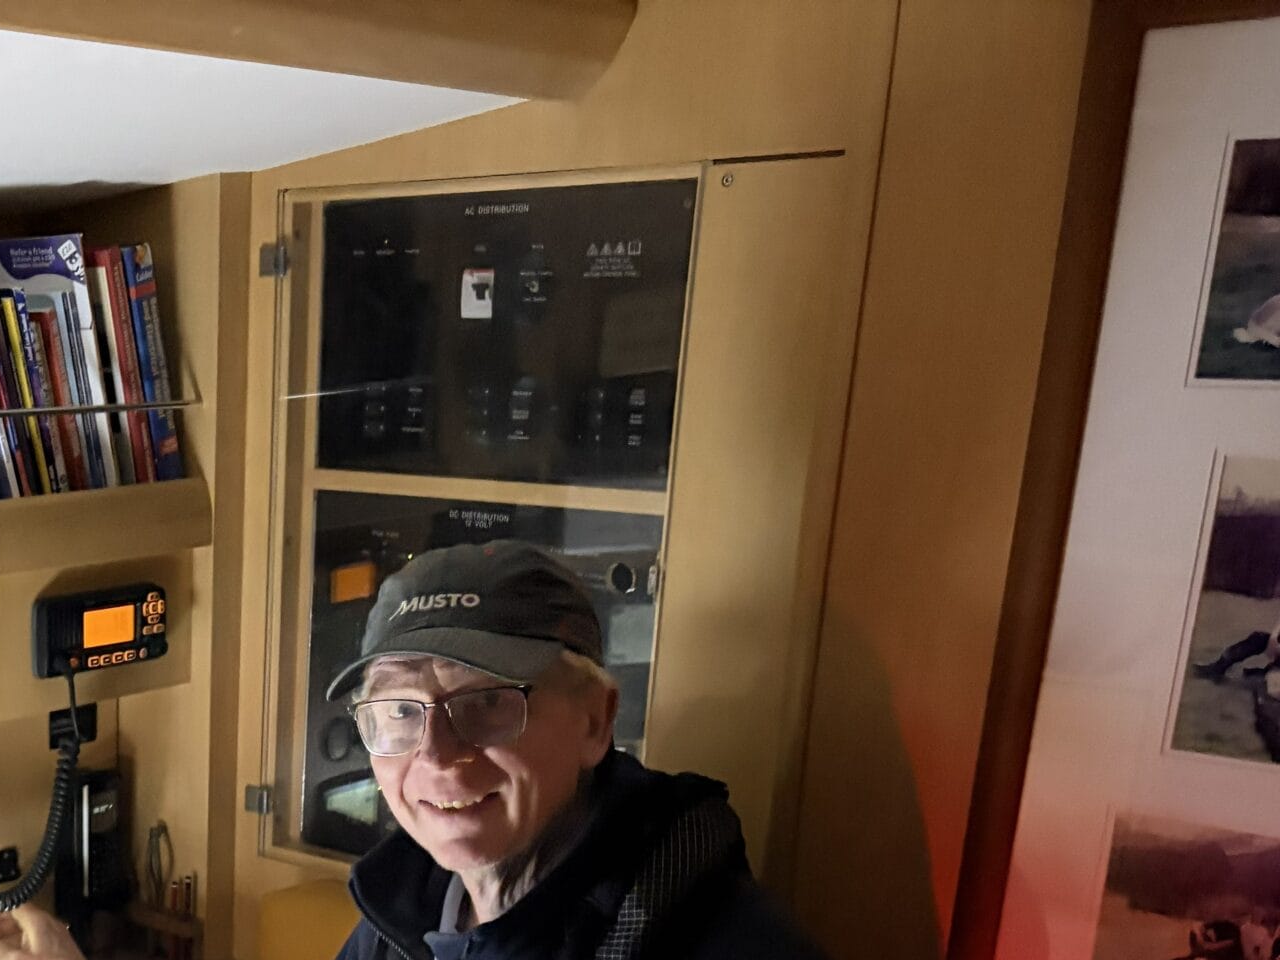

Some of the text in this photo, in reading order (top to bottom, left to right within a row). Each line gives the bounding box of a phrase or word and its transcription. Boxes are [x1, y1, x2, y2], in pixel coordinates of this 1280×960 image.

[464, 203, 530, 216] AC DISTRIBUTION
[461, 510, 510, 523] DISTRIBUTION
[388, 593, 481, 623] MUSTO
